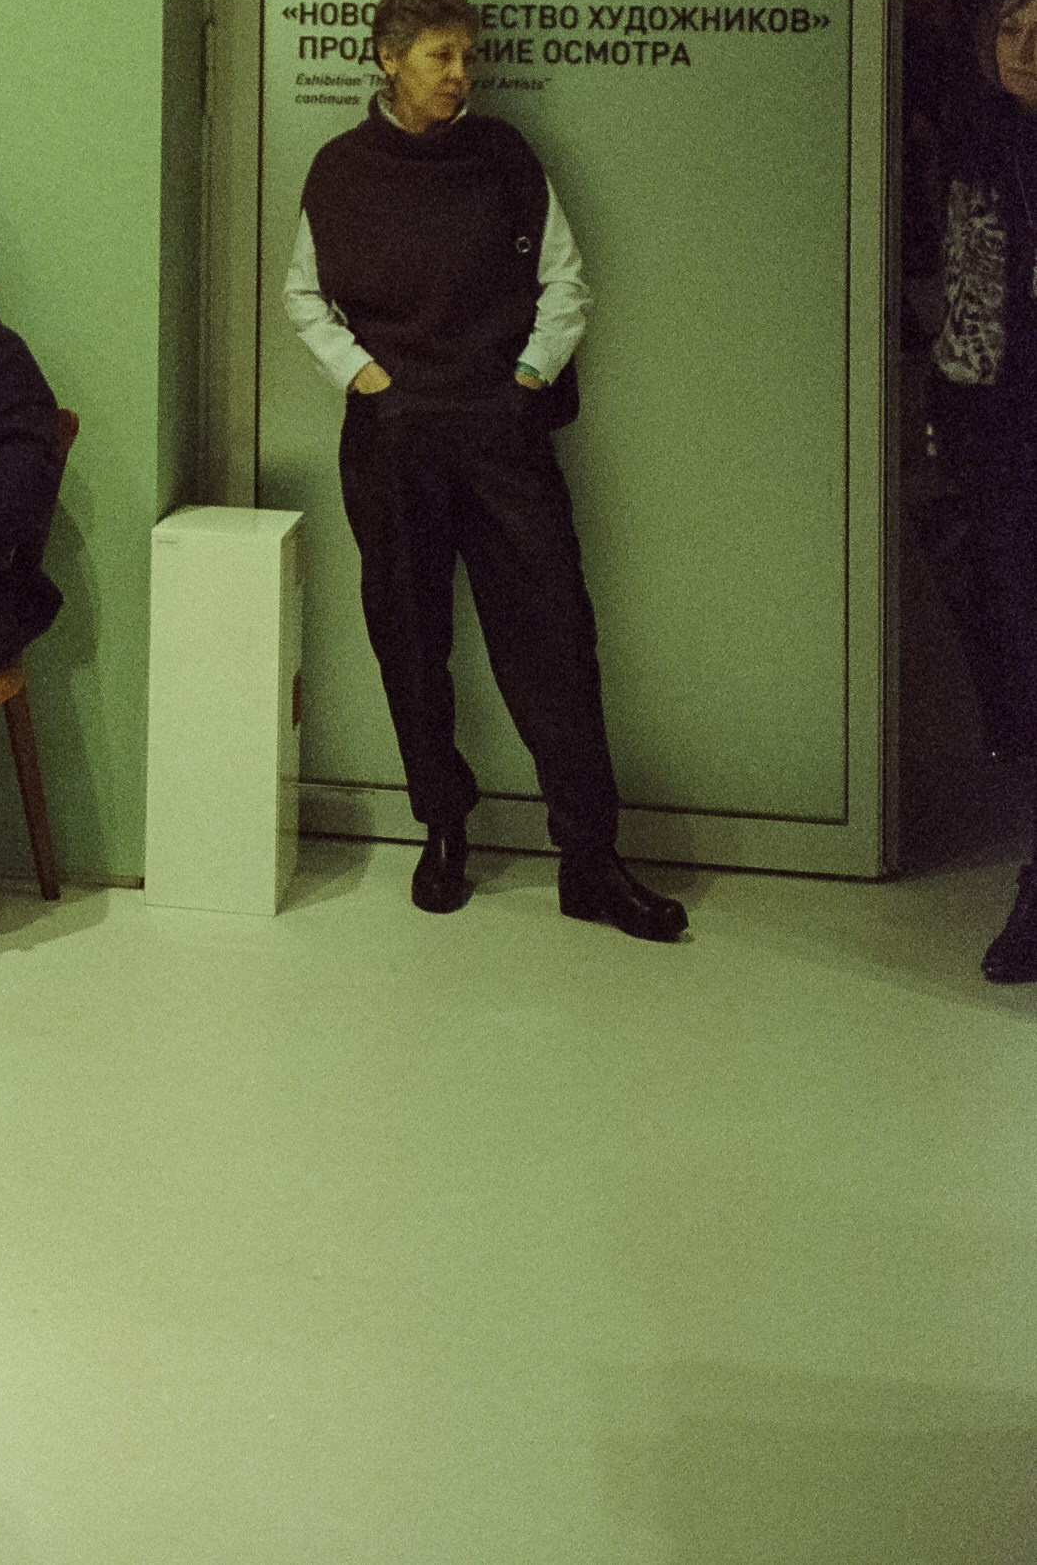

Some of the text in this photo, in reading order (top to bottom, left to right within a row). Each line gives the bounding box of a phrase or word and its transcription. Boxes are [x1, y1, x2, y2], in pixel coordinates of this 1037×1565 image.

[282, 1, 831, 35] «НОВО ЕСТВО ХУДОЖНИКОВ»
[299, 35, 691, 67] ПРОДНИЕ ОСМОТРА
